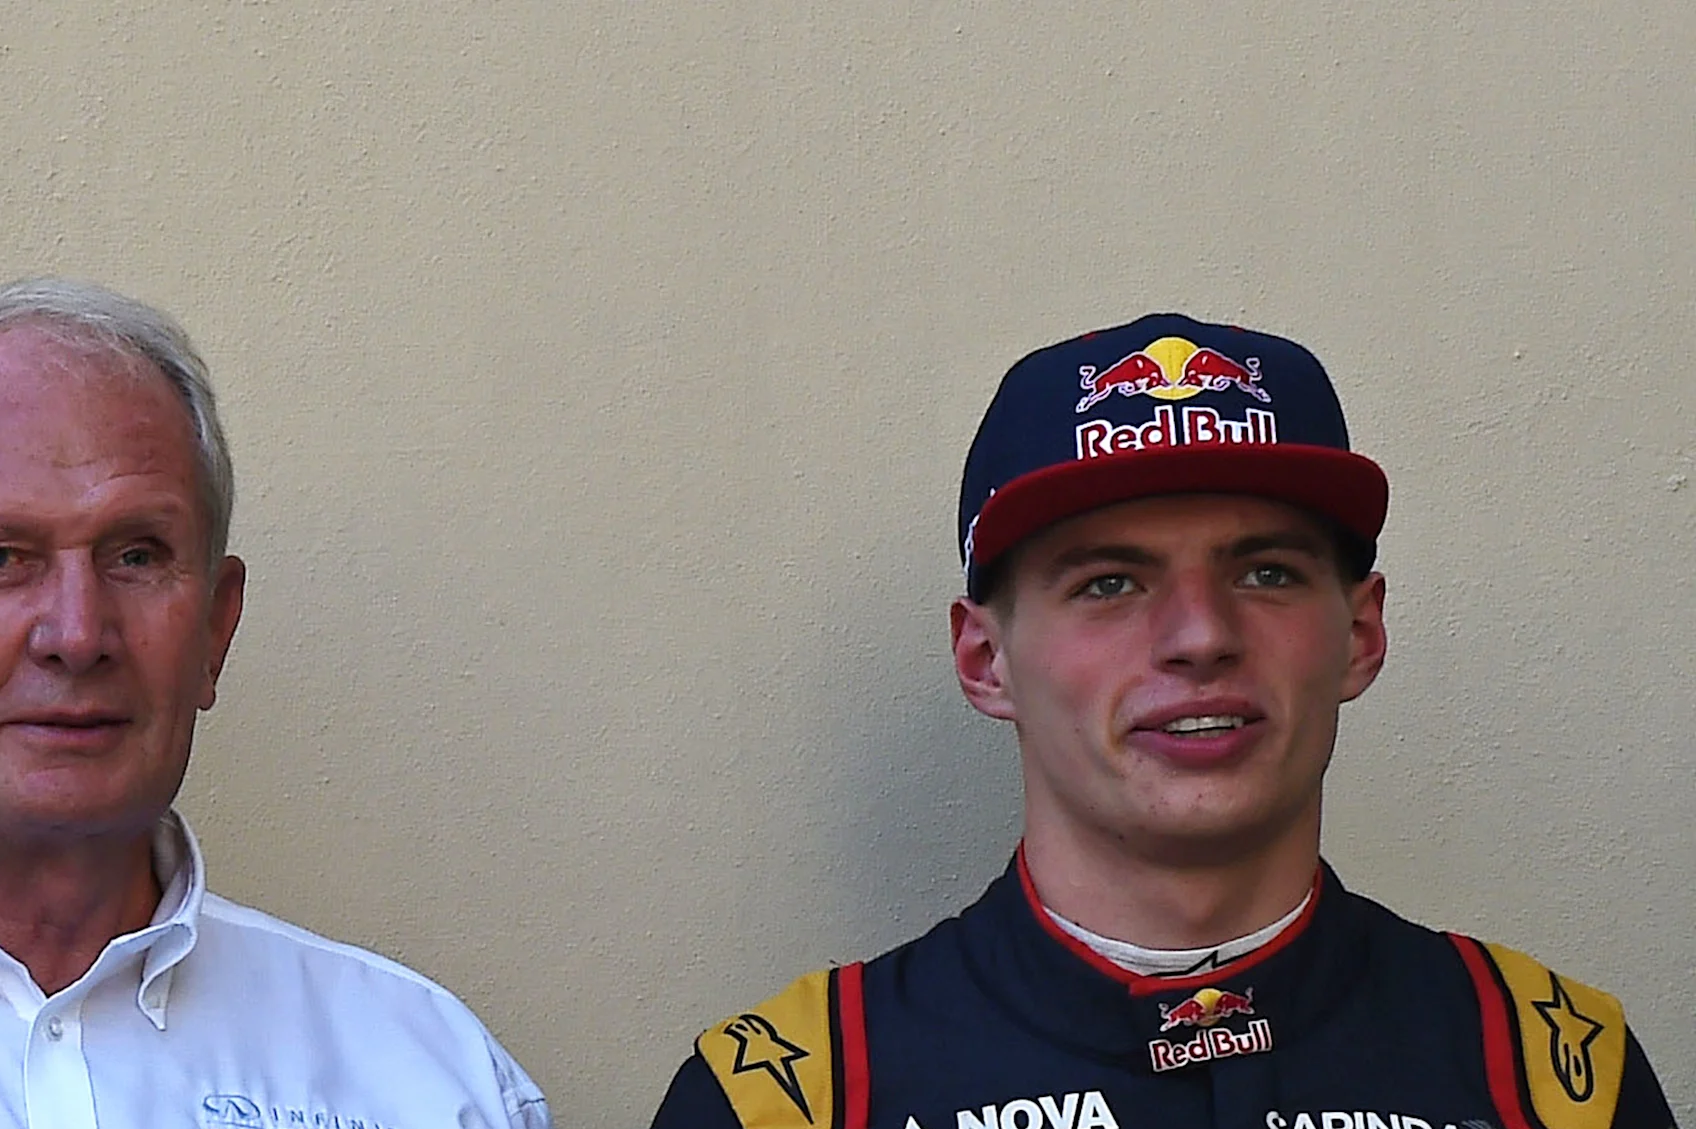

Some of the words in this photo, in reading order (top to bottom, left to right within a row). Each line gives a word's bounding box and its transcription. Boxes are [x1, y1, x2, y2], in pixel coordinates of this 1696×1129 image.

[1076, 405, 1176, 460] Red
[1183, 406, 1277, 445] Bull
[1149, 1029, 1211, 1072] Red
[1209, 1019, 1272, 1058] Bull
